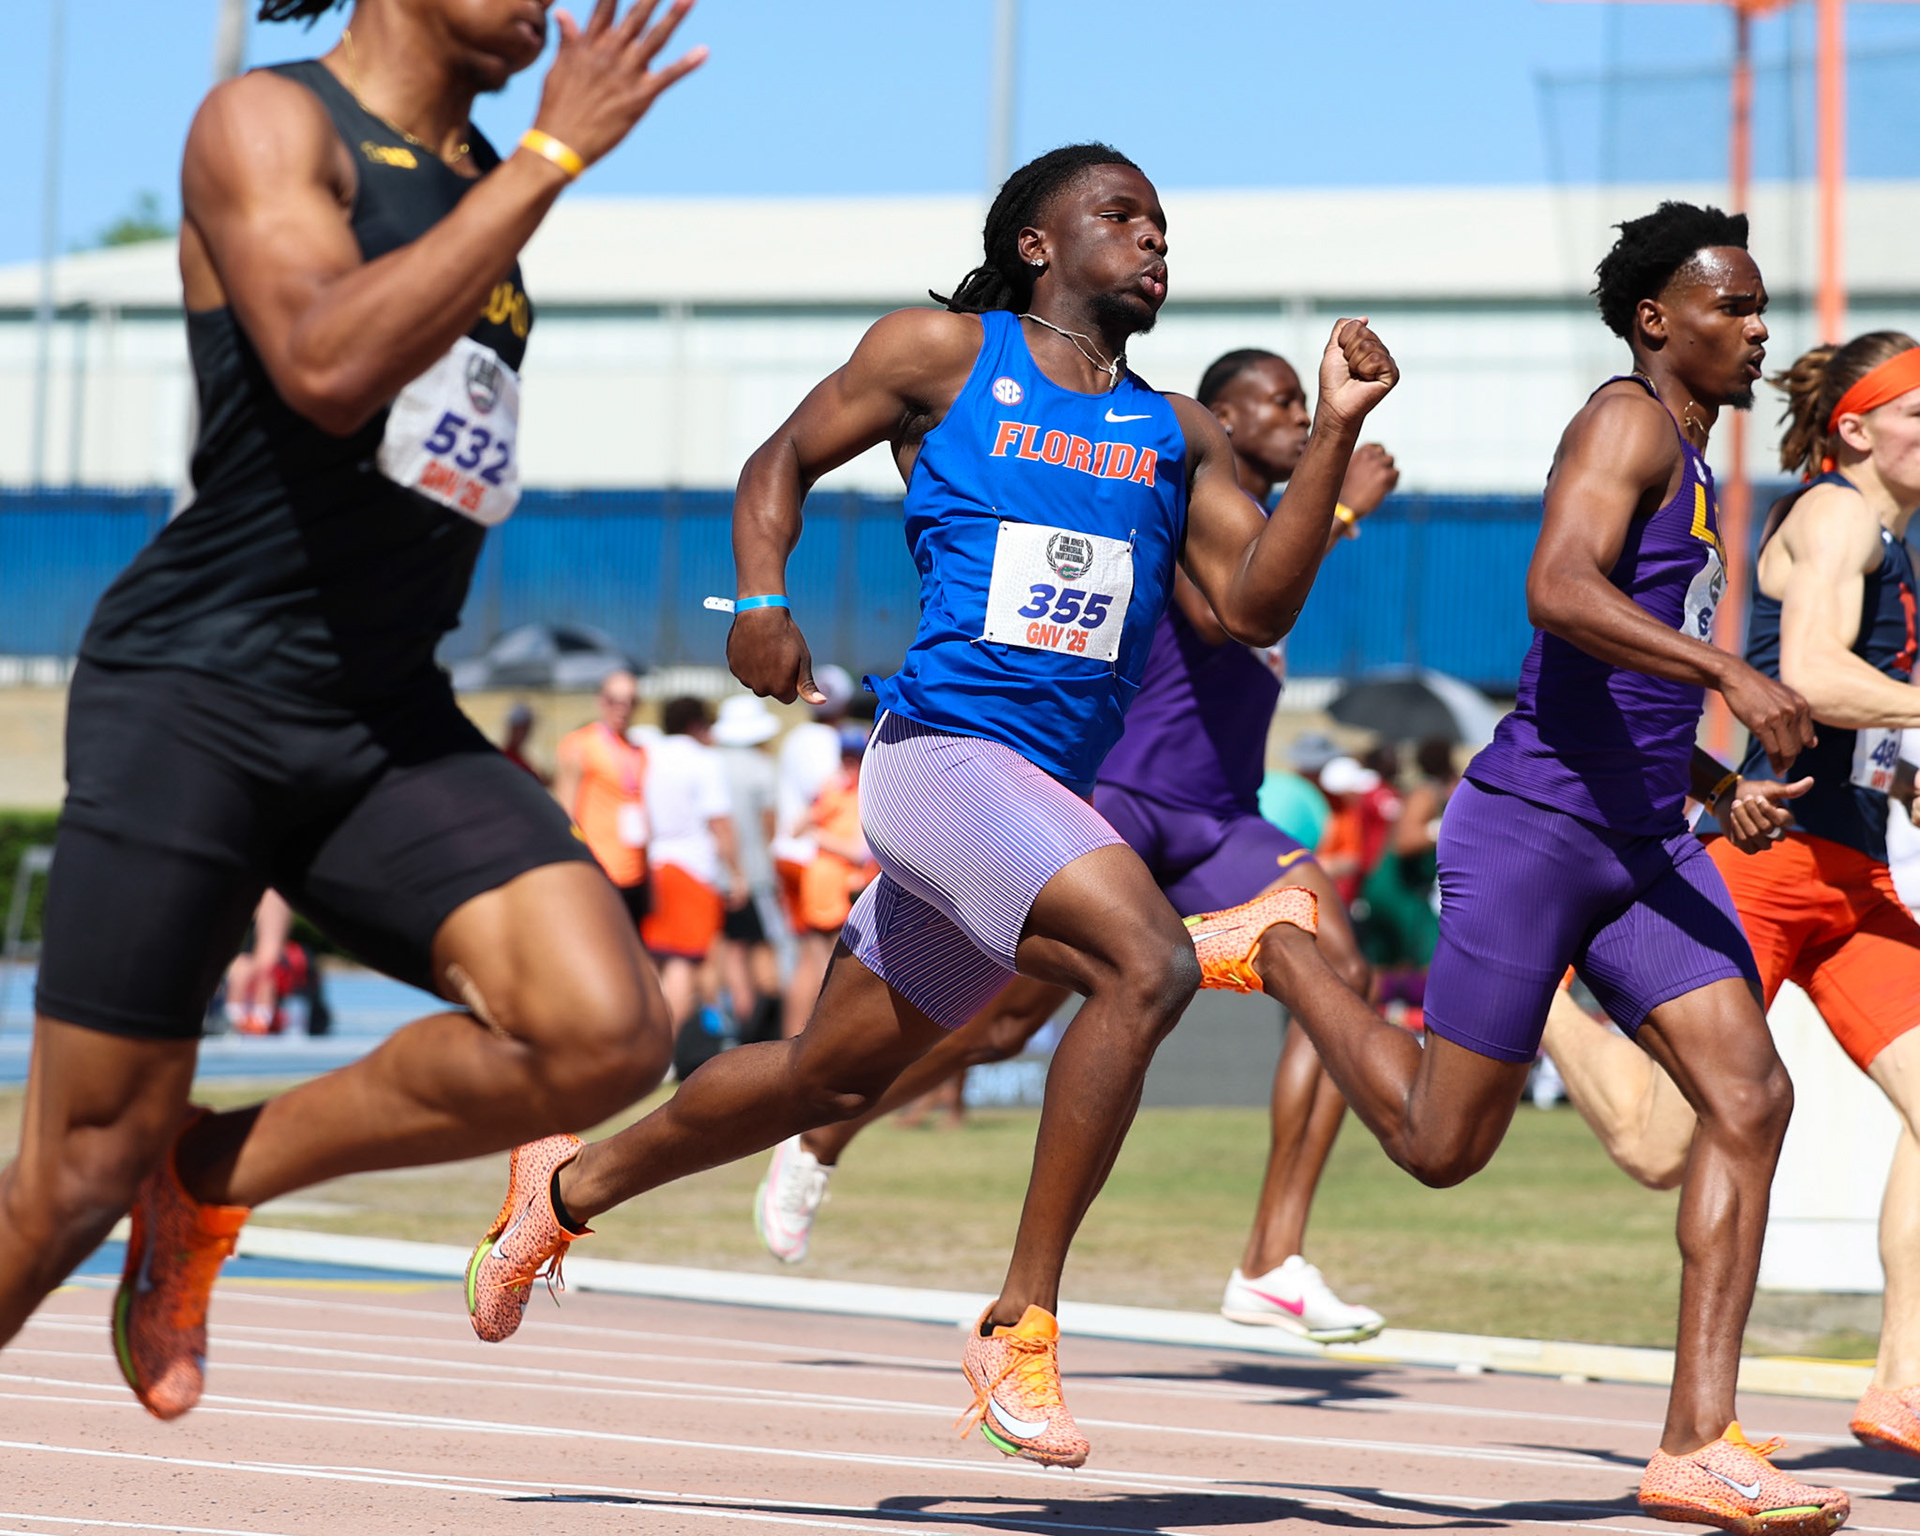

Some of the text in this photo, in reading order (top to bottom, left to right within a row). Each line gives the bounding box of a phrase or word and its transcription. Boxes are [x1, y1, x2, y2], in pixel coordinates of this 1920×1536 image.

[994, 377, 1023, 405] SEC
[424, 411, 509, 487] 532
[989, 420, 1158, 488] FLORIDA
[1055, 551, 1085, 564] INVITATIONAL
[1059, 544, 1083, 556] MEMORIAL
[1017, 584, 1114, 630] 355
[1026, 622, 1089, 653] GNV '25
